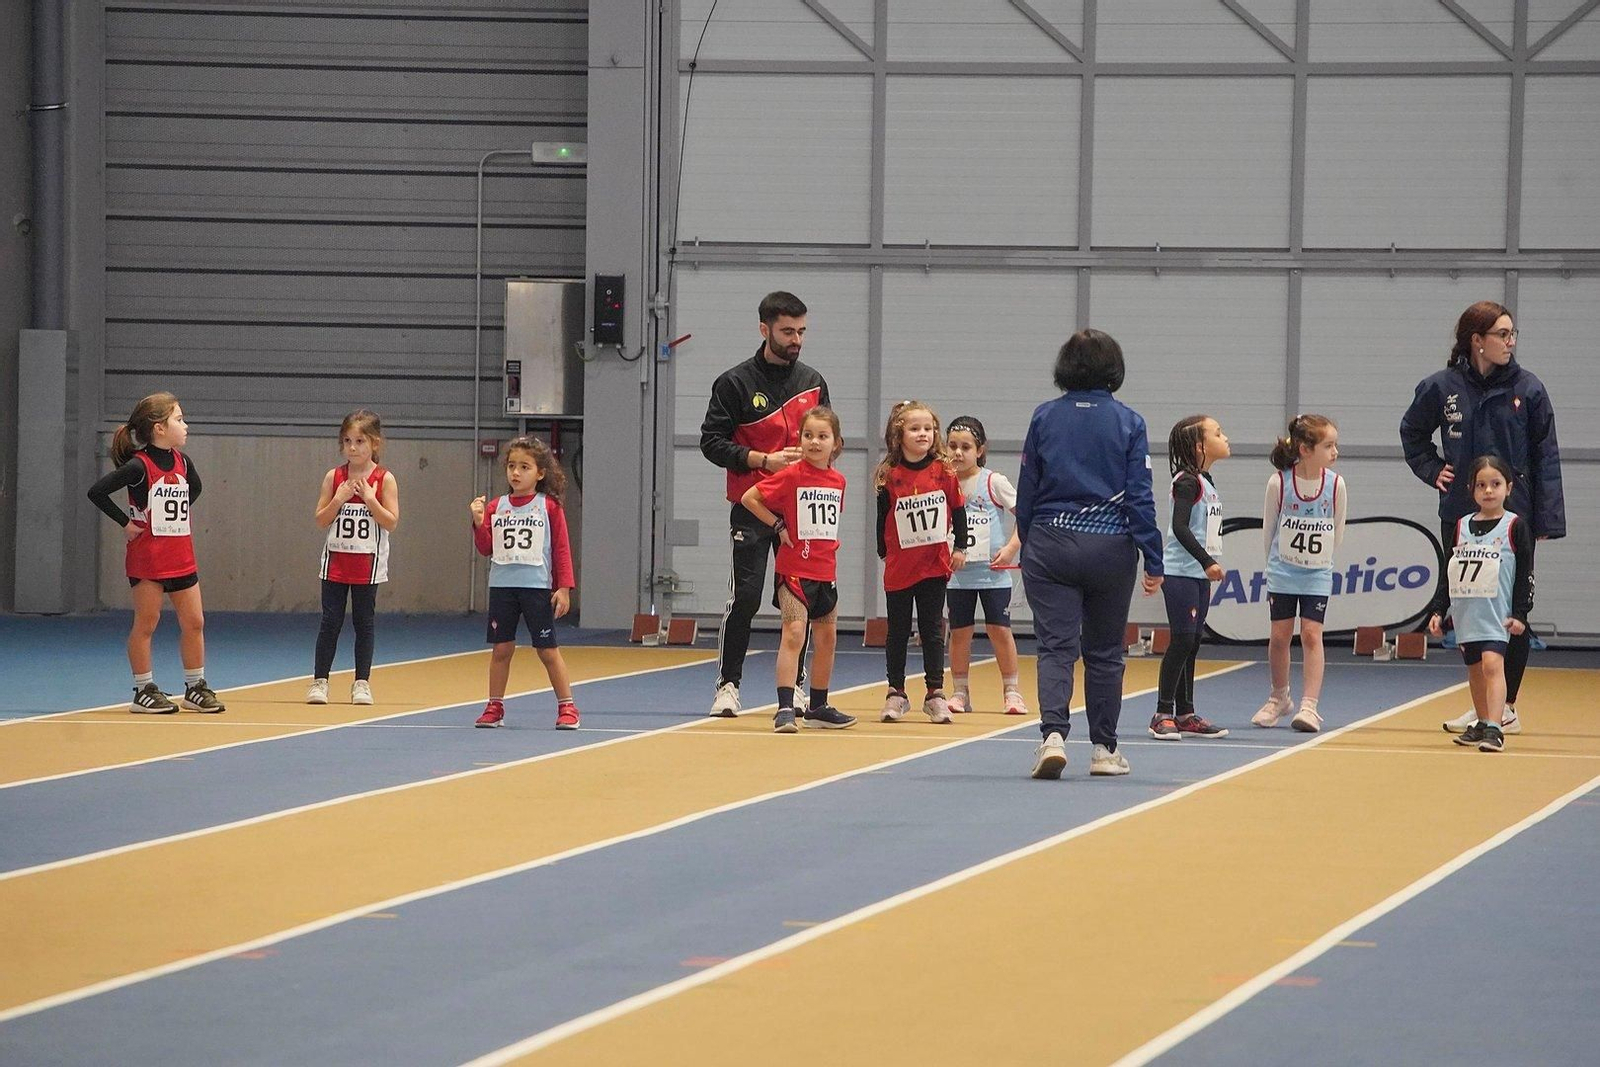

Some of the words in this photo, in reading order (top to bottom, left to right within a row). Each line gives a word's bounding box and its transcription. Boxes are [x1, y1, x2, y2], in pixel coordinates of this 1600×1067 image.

[164, 500, 188, 521] 99
[807, 502, 837, 525] 113
[896, 494, 945, 512] Atlántico
[335, 517, 369, 539] 198
[494, 515, 544, 528] Atlántico
[906, 507, 939, 532] 117
[1282, 518, 1333, 532] Atlántico
[503, 528, 533, 550] 53
[1290, 532, 1322, 554] 46
[1458, 560, 1483, 583] 77
